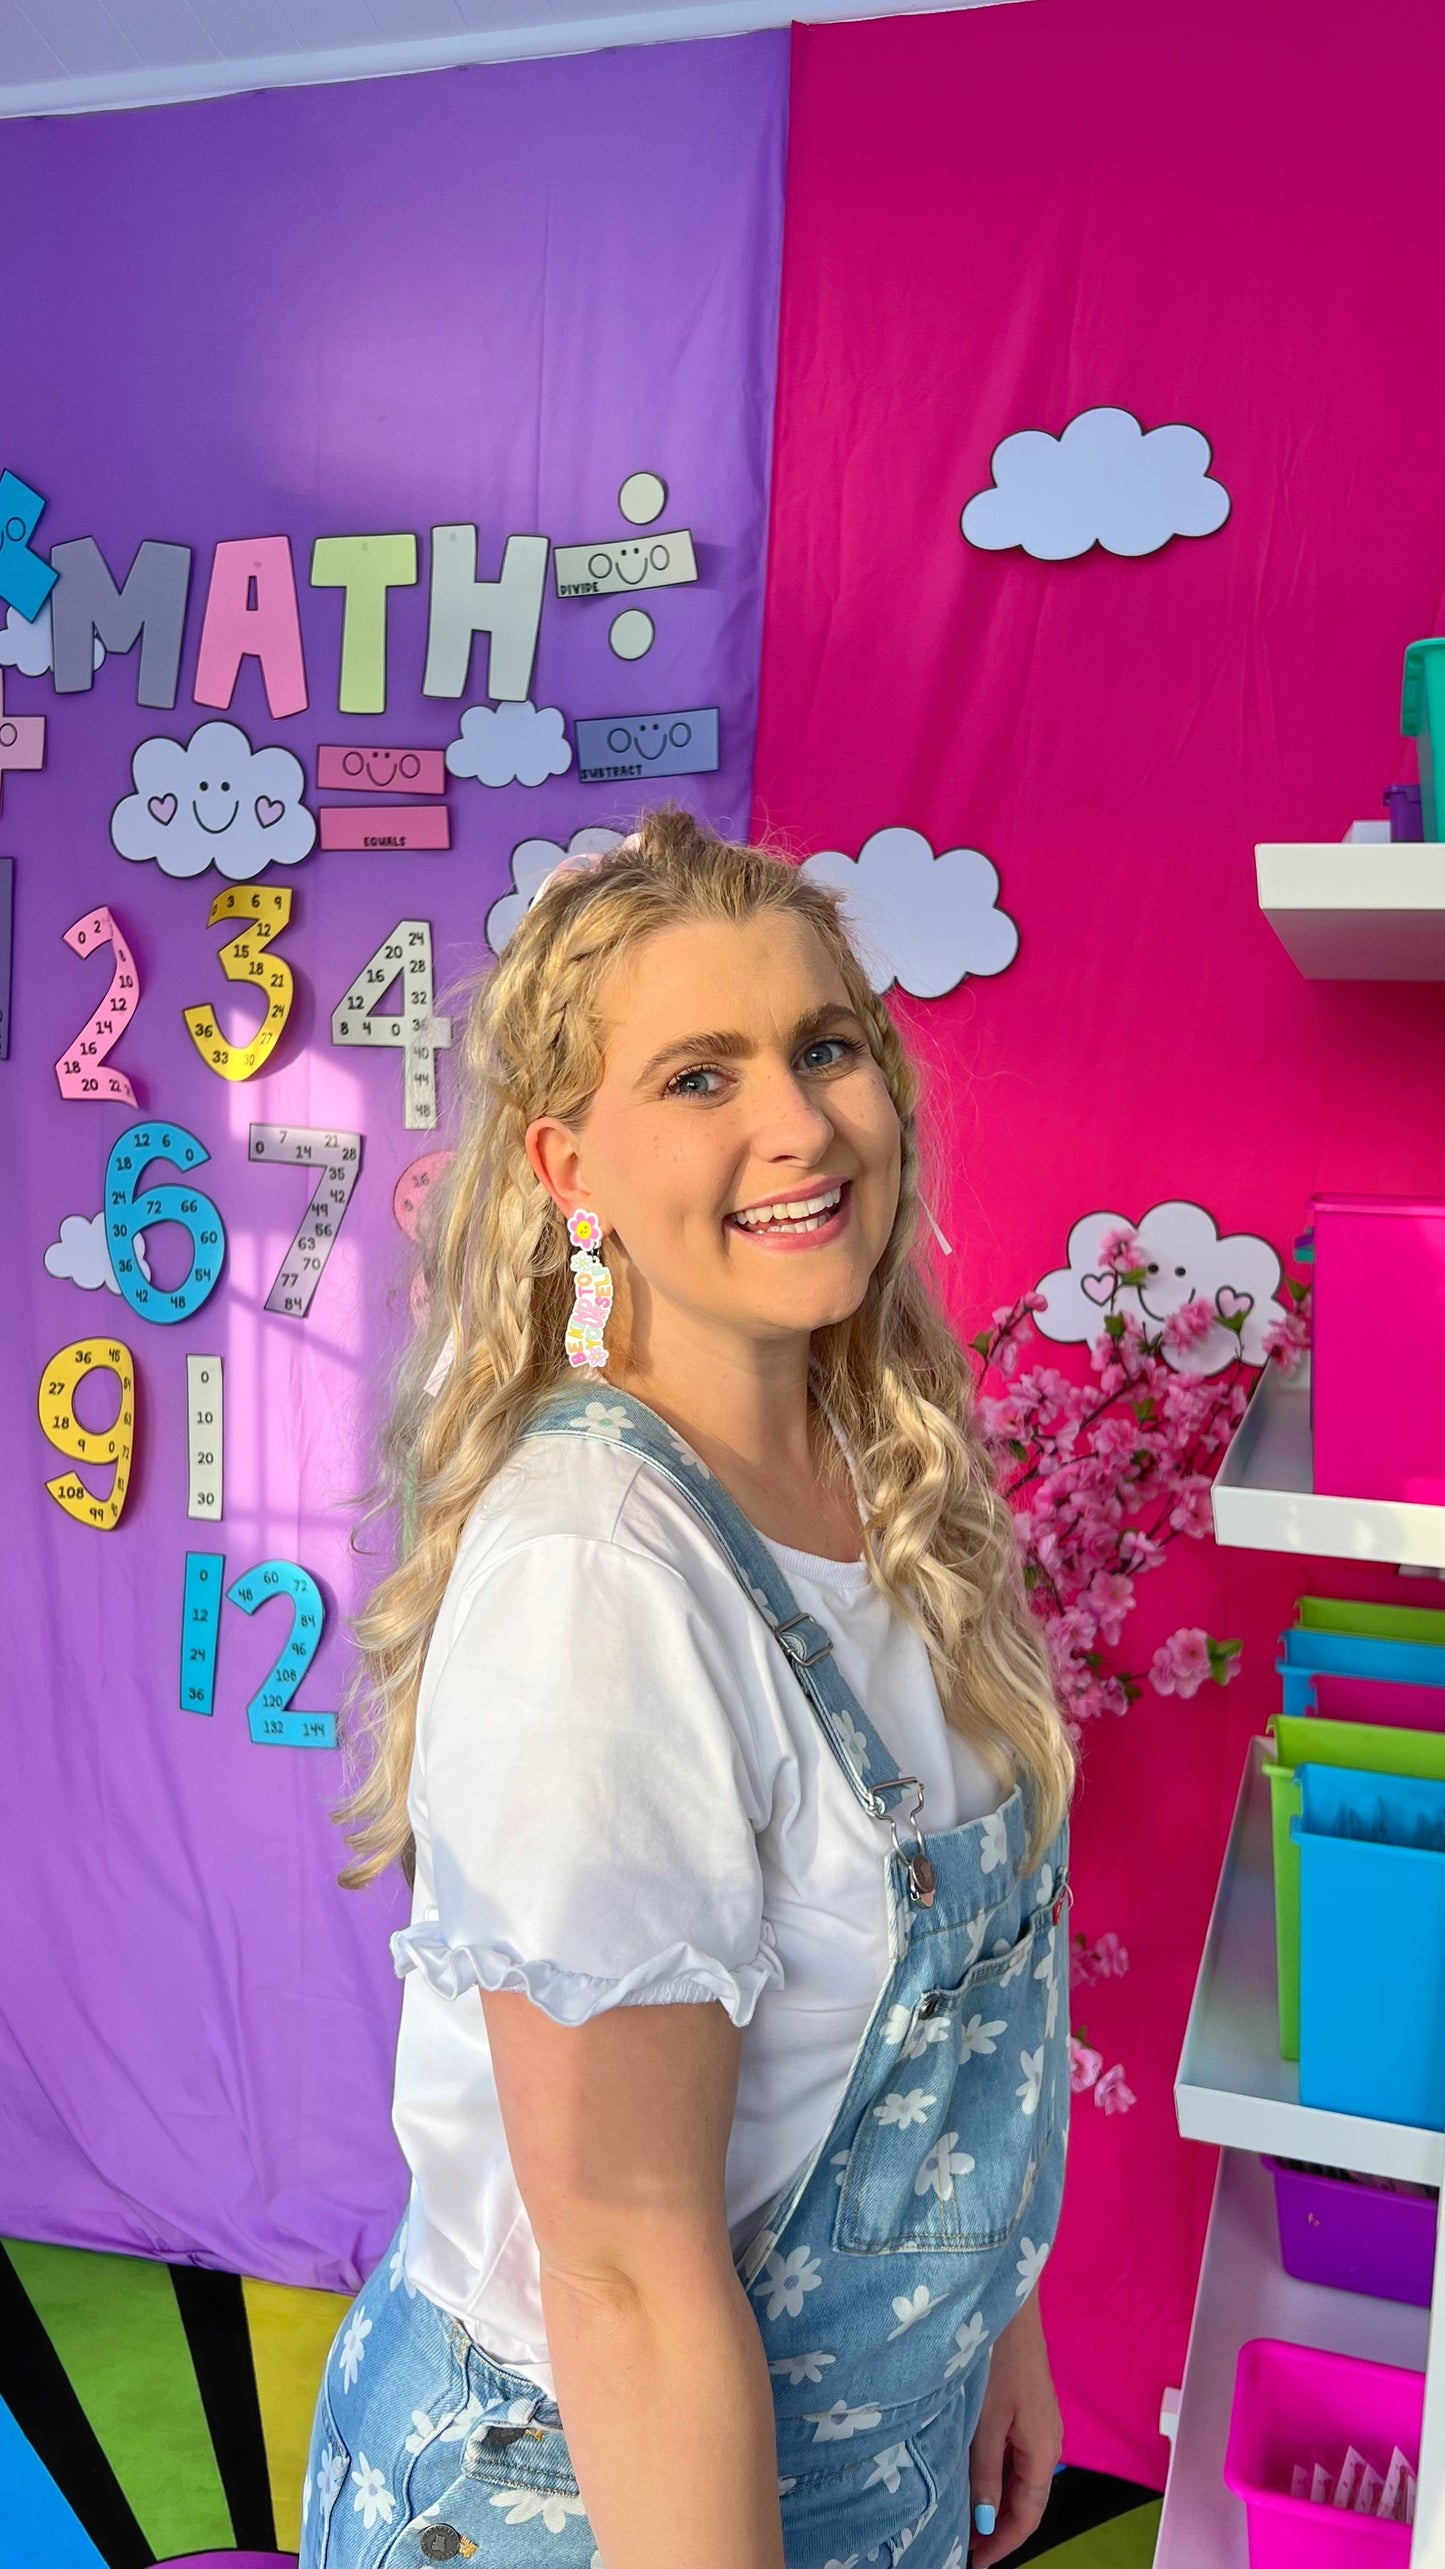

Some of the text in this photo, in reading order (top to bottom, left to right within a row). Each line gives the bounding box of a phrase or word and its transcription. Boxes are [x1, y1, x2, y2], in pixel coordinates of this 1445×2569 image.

[560, 582, 600, 596] DIVIDE
[50, 523, 550, 720] MATH
[580, 764, 643, 780] SUBTRACT
[363, 835, 407, 848] EQUALS
[227, 895, 235, 908] 3
[251, 894, 260, 908] 6
[274, 896, 282, 910] 9
[78, 931, 86, 944] 0
[94, 920, 101, 933] 2
[256, 923, 271, 937] 12
[409, 932, 424, 946] 24
[234, 945, 249, 958] 15
[385, 946, 403, 959] 20
[249, 962, 264, 975] 18
[410, 960, 426, 973] 28
[119, 975, 133, 988] 10
[270, 974, 284, 988] 21
[366, 969, 385, 983] 16
[111, 998, 127, 1011] 12
[347, 996, 364, 1010] 12
[411, 991, 427, 1005] 32
[272, 1005, 285, 1018] 24
[96, 1021, 113, 1034] 14
[195, 1024, 213, 1038] 36
[340, 1022, 349, 1035] 8
[363, 1022, 372, 1035] 4
[392, 1023, 400, 1036] 0
[260, 1032, 273, 1045] 27
[80, 1042, 97, 1055] 16
[414, 1047, 429, 1060] 40
[212, 1050, 255, 1066] 33 30
[64, 1061, 81, 1074] 18
[82, 1079, 98, 1091] 20
[414, 1073, 429, 1086] 44
[416, 1104, 430, 1117] 48
[135, 1134, 171, 1148] 12 6
[279, 1131, 288, 1144] 7
[324, 1135, 339, 1148] 21
[185, 1148, 194, 1161] 0
[255, 1141, 312, 1159] 0 14
[342, 1148, 357, 1161] 28
[116, 1157, 132, 1171] 18
[329, 1167, 345, 1181] 35
[112, 1191, 126, 1205] 24
[330, 1190, 345, 1204] 42
[147, 1199, 198, 1215] 72 66
[312, 1203, 328, 1217] 49
[113, 1224, 127, 1238] 30
[315, 1223, 332, 1237] 56
[201, 1231, 218, 1244] 60
[298, 1237, 315, 1251] 63
[119, 1259, 132, 1272] 36
[303, 1258, 321, 1271] 70
[195, 1268, 211, 1282] 54
[282, 1273, 299, 1287] 77
[136, 1289, 186, 1309] 42 48
[285, 1298, 302, 1311] 84
[585, 1265, 611, 1350] YOURSELF
[567, 1272, 593, 1365] BE KIND TO
[75, 1351, 92, 1364] 36
[201, 1371, 209, 1384] 0
[49, 1382, 65, 1395] 27
[52, 1416, 70, 1430] 18
[197, 1412, 213, 1424] 10
[78, 1439, 115, 1453] 9 0
[122, 1445, 130, 1460] 72
[198, 1452, 214, 1465] 20
[58, 1486, 84, 1499] 108
[197, 1492, 214, 1505] 30
[89, 1508, 104, 1521] 99
[200, 1569, 208, 1581] 0
[264, 1572, 279, 1584] 60
[293, 1579, 307, 1592] 72
[238, 1588, 253, 1601] 48
[192, 1608, 208, 1622] 12
[301, 1615, 315, 1628] 84
[190, 1648, 205, 1661] 24
[292, 1643, 307, 1656] 96
[275, 1669, 297, 1682] 108
[189, 1687, 204, 1700] 36
[262, 1695, 283, 1708] 120
[264, 1721, 325, 1737] 132 144
